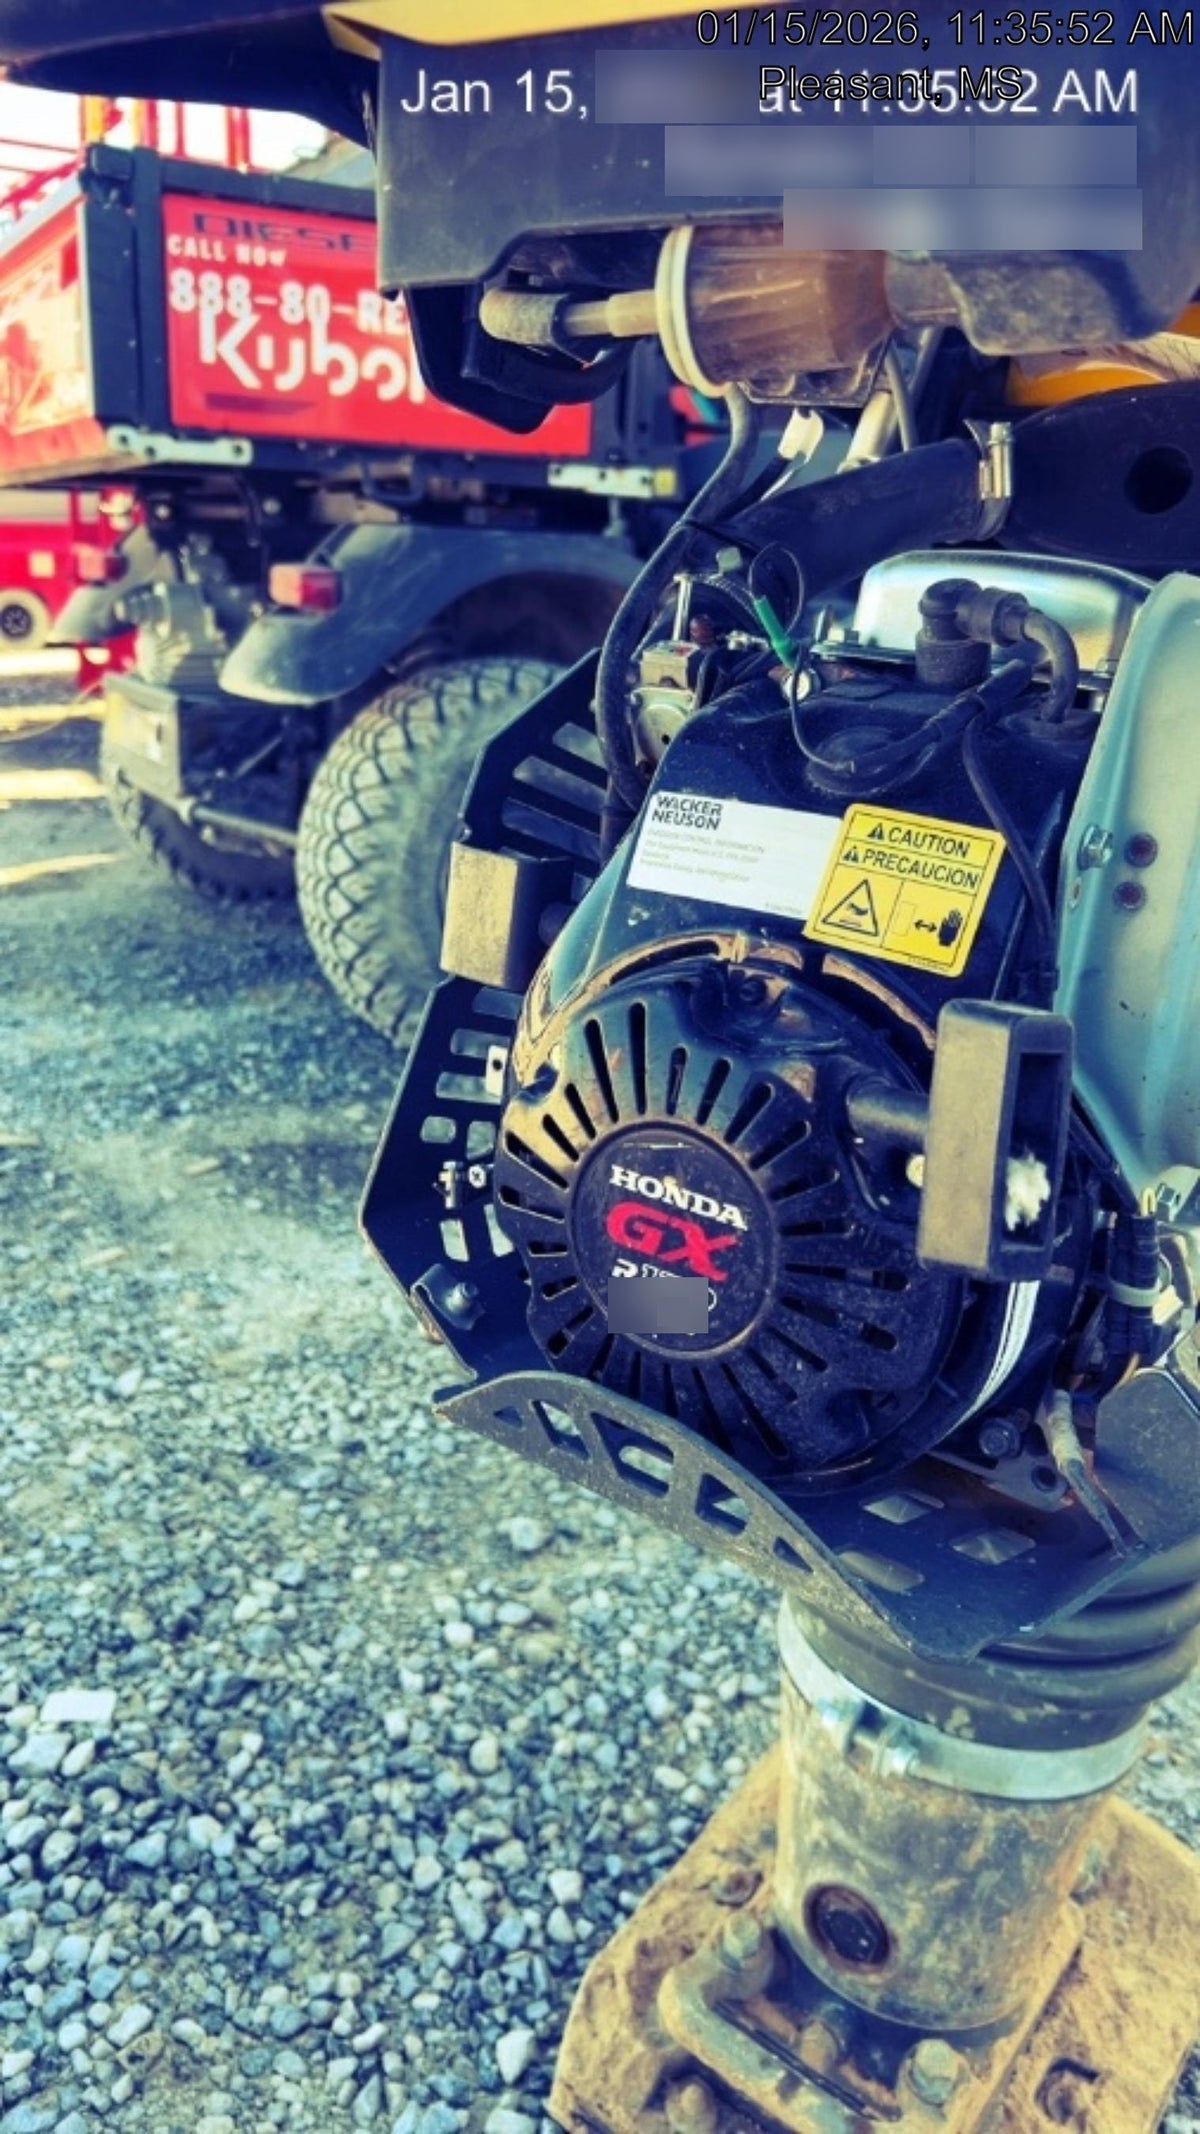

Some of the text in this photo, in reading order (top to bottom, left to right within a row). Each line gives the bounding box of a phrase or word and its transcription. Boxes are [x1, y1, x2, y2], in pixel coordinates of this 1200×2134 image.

[167, 234, 287, 267] CALL NOW
[652, 810, 721, 831] NEUSON
[656, 795, 723, 816] WACKER
[888, 827, 971, 859] CAUTION
[609, 1164, 748, 1231] HONDA
[605, 1201, 741, 1281] GX
